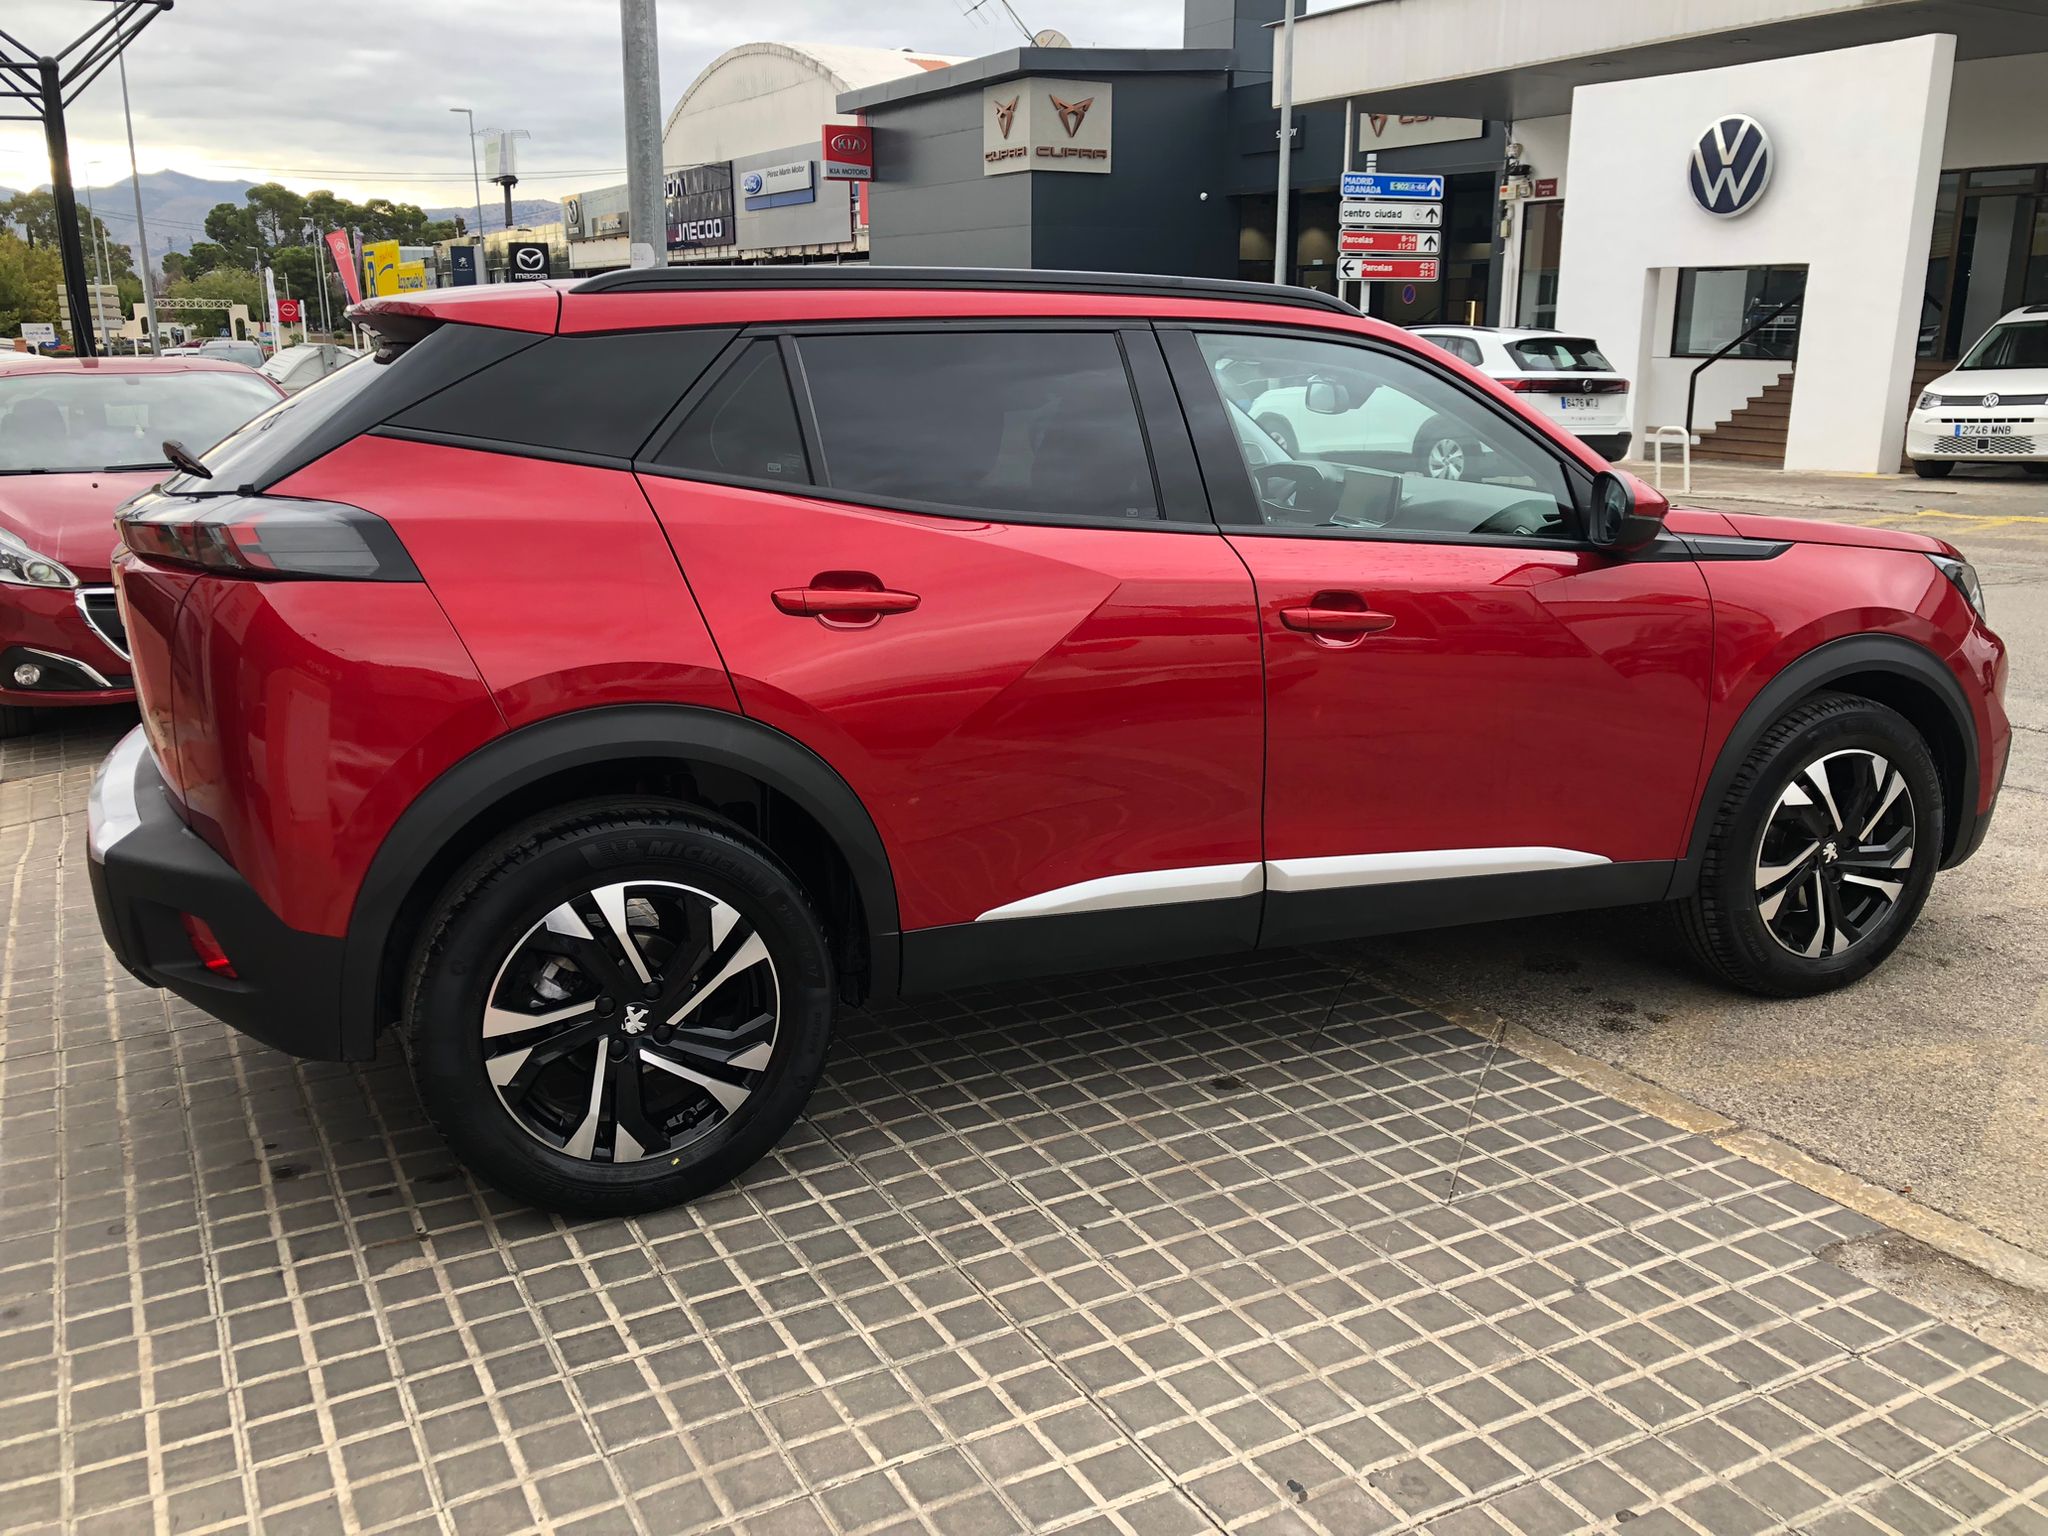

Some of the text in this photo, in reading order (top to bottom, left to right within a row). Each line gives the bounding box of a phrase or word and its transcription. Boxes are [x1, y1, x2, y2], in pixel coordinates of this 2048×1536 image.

[837, 138, 861, 151] KIA
[985, 146, 1028, 163] CUPRA
[1036, 146, 1108, 160] CUPRA
[842, 168, 868, 176] MOTORS
[1344, 176, 1374, 186] MADRID
[1344, 185, 1382, 194] GRANADA
[1343, 208, 1402, 219] centro ciudad
[675, 218, 722, 242] JAECOO
[1342, 235, 1374, 244] Parcelas
[1362, 263, 1393, 272] Parcelas
[1962, 425, 2012, 435] 2746 MNB
